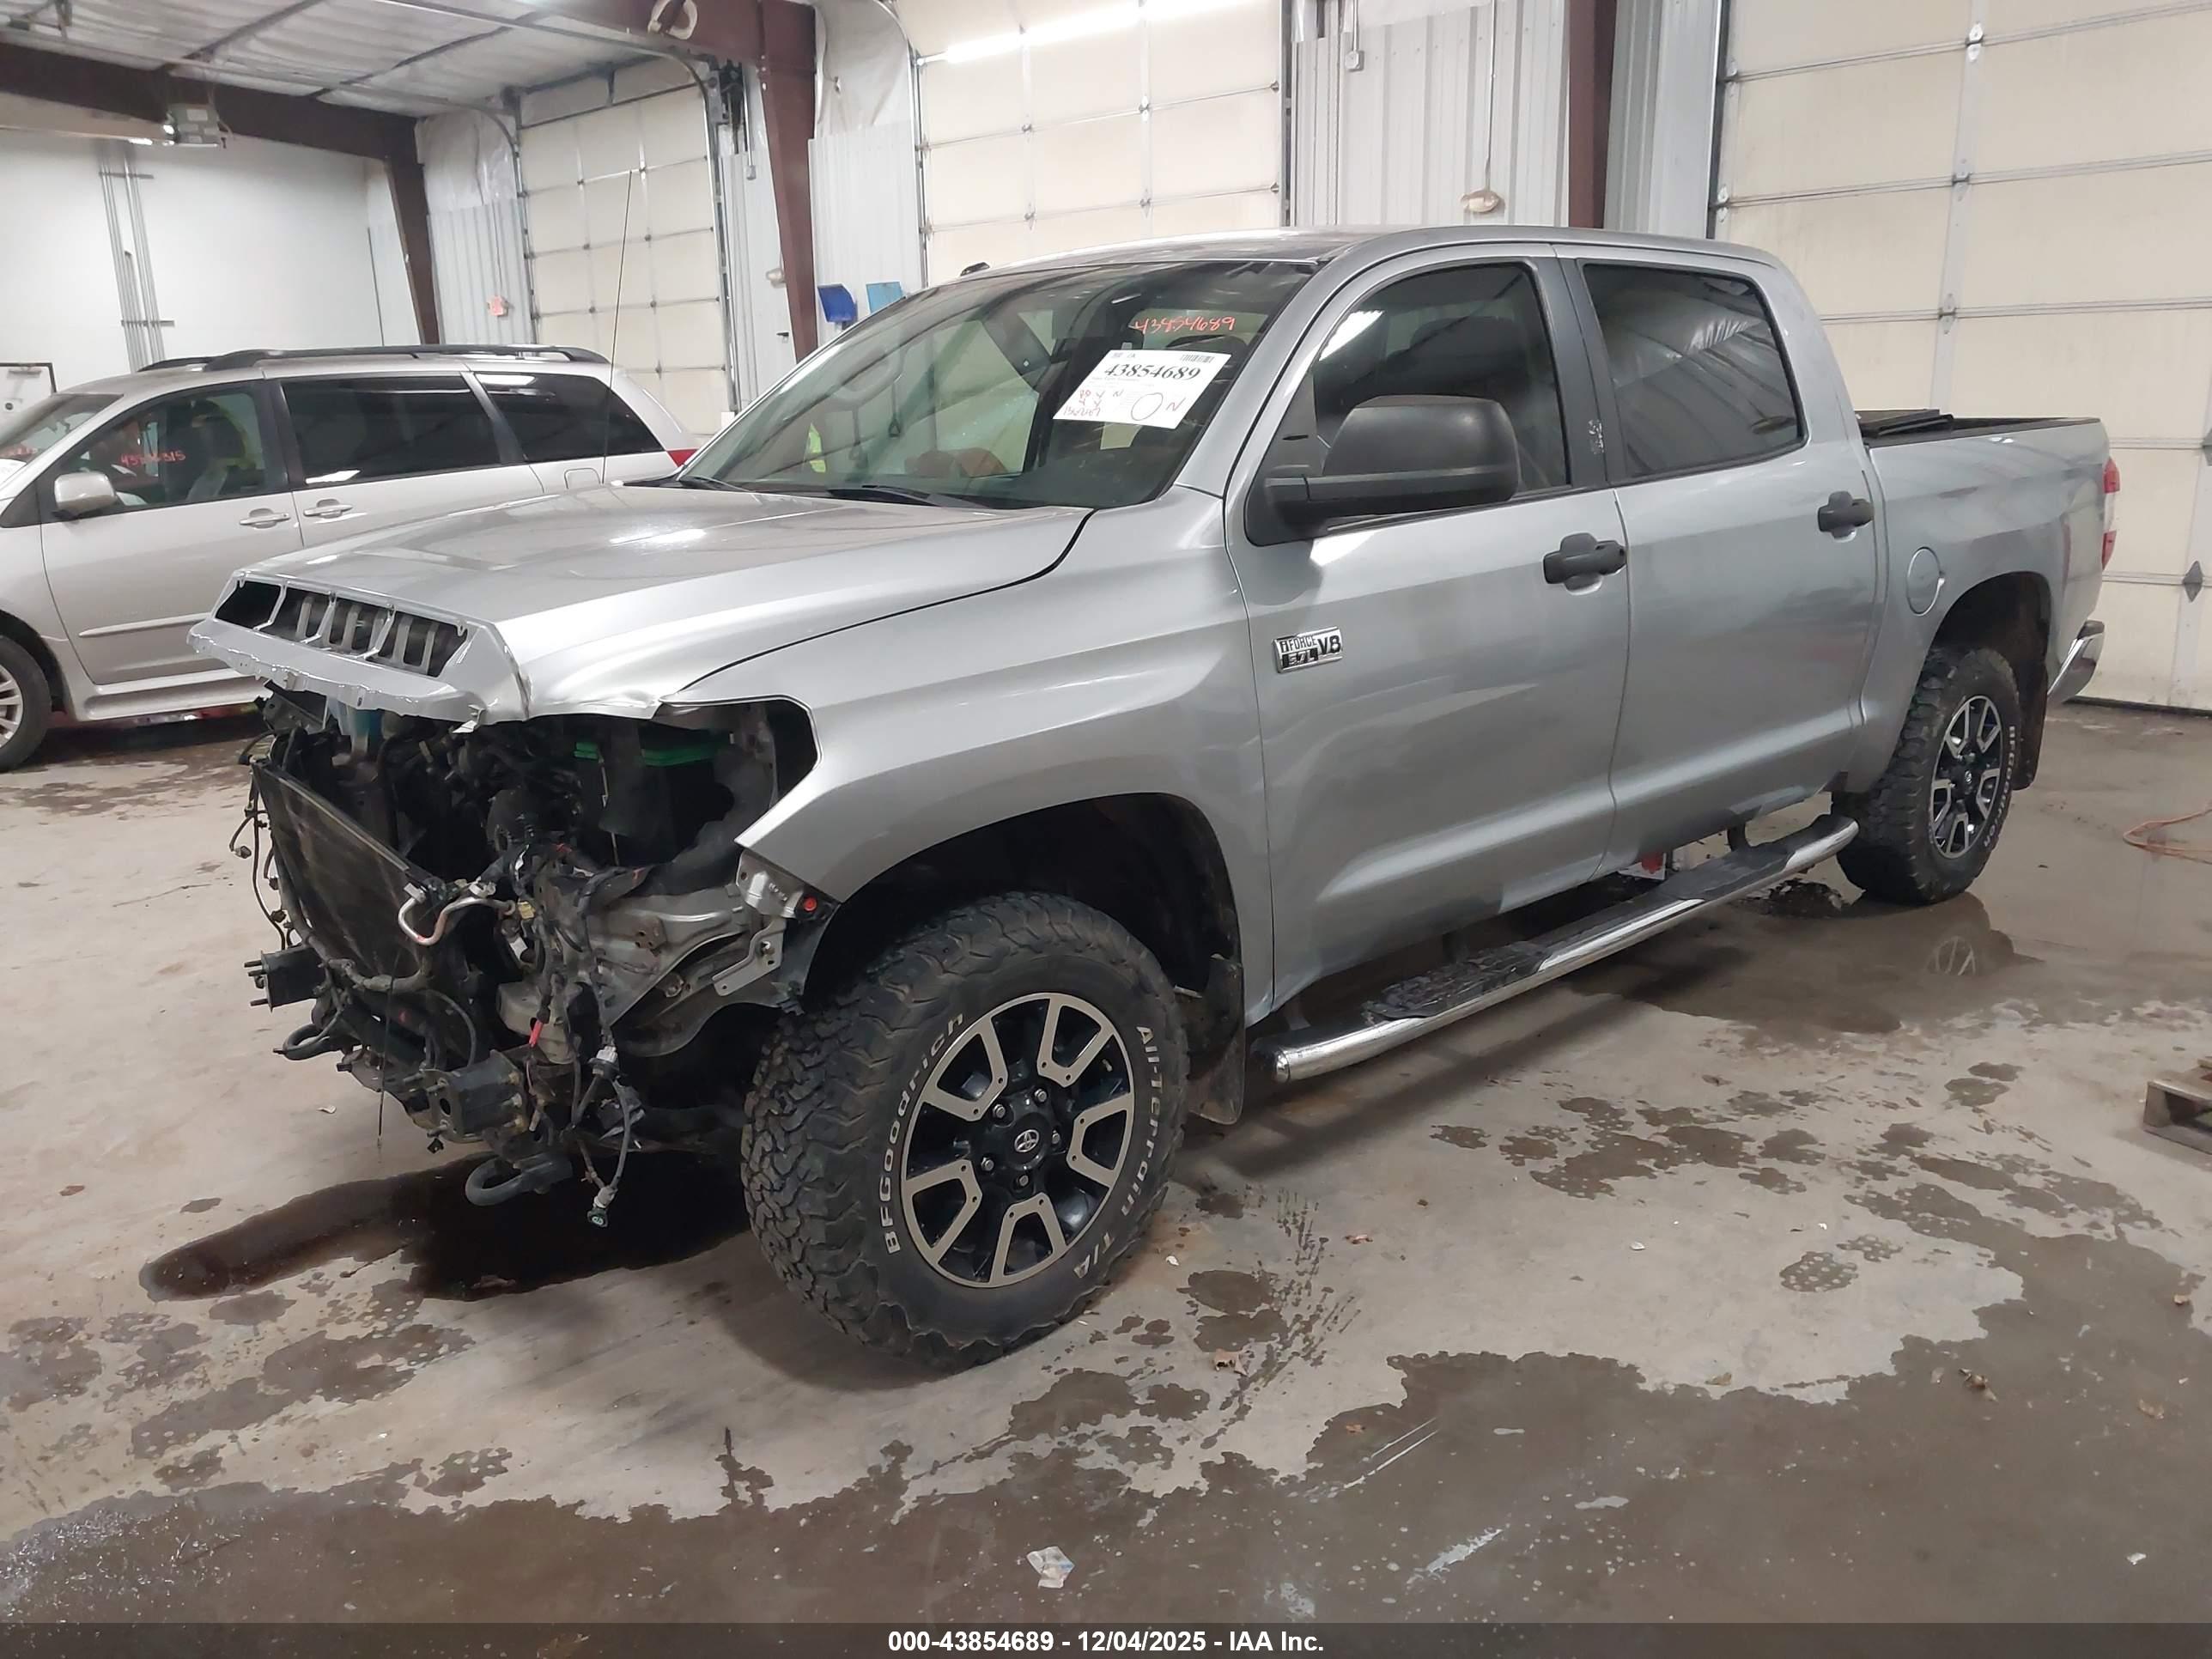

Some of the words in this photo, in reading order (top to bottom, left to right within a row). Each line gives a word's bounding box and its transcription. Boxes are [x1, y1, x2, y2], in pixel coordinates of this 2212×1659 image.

[1104, 363, 1201, 381] 43854689
[1318, 635, 1341, 655] V8
[879, 1013, 963, 1254] BFGoodrich
[1121, 1026, 1163, 1216] All-Terrain
